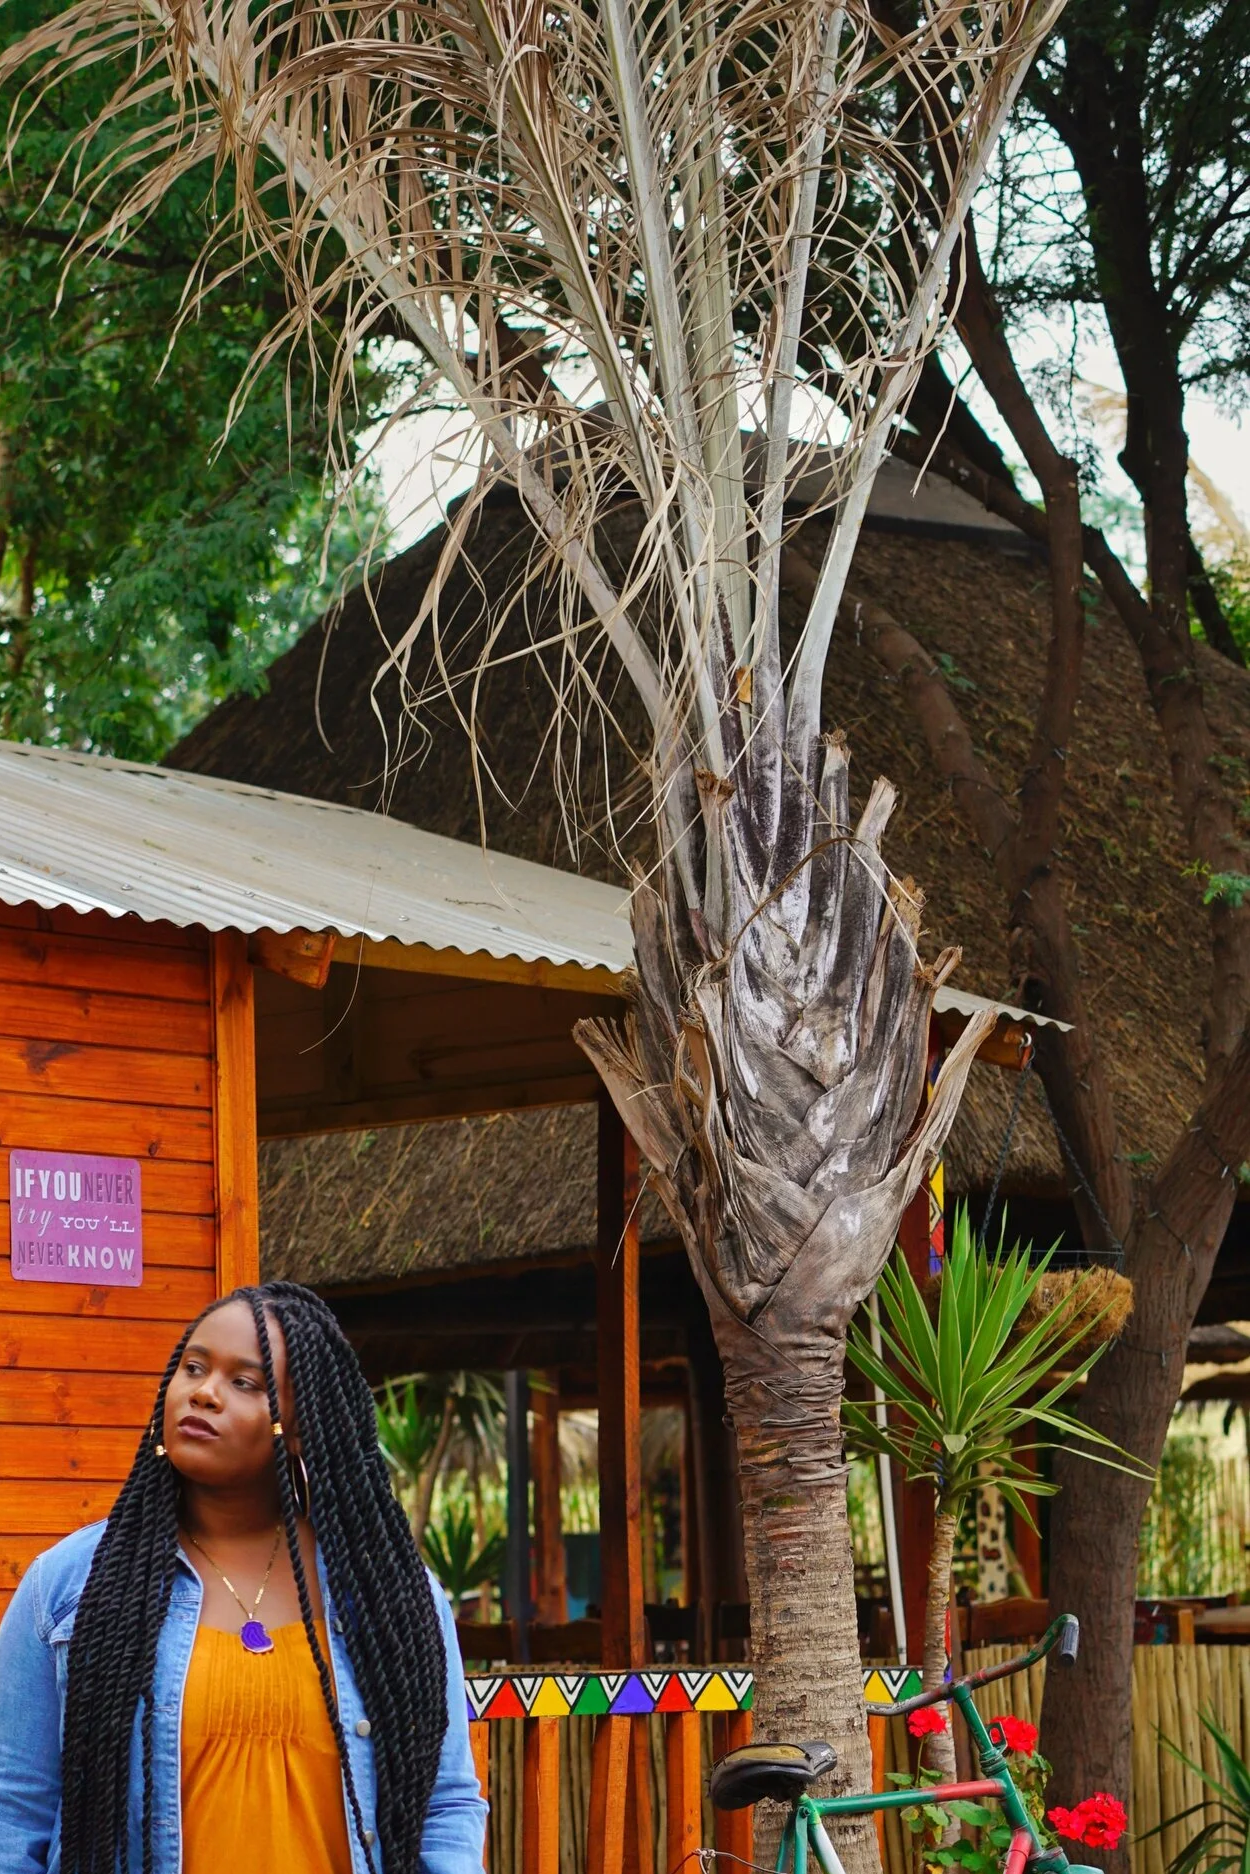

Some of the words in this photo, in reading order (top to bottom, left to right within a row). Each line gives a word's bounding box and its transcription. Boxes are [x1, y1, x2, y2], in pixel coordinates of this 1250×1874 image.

[84, 1172, 135, 1205] NEVER
[17, 1202, 53, 1236] try
[59, 1215, 135, 1233] YOU'LL
[17, 1241, 64, 1267] NEVER
[68, 1244, 135, 1271] KNOW
